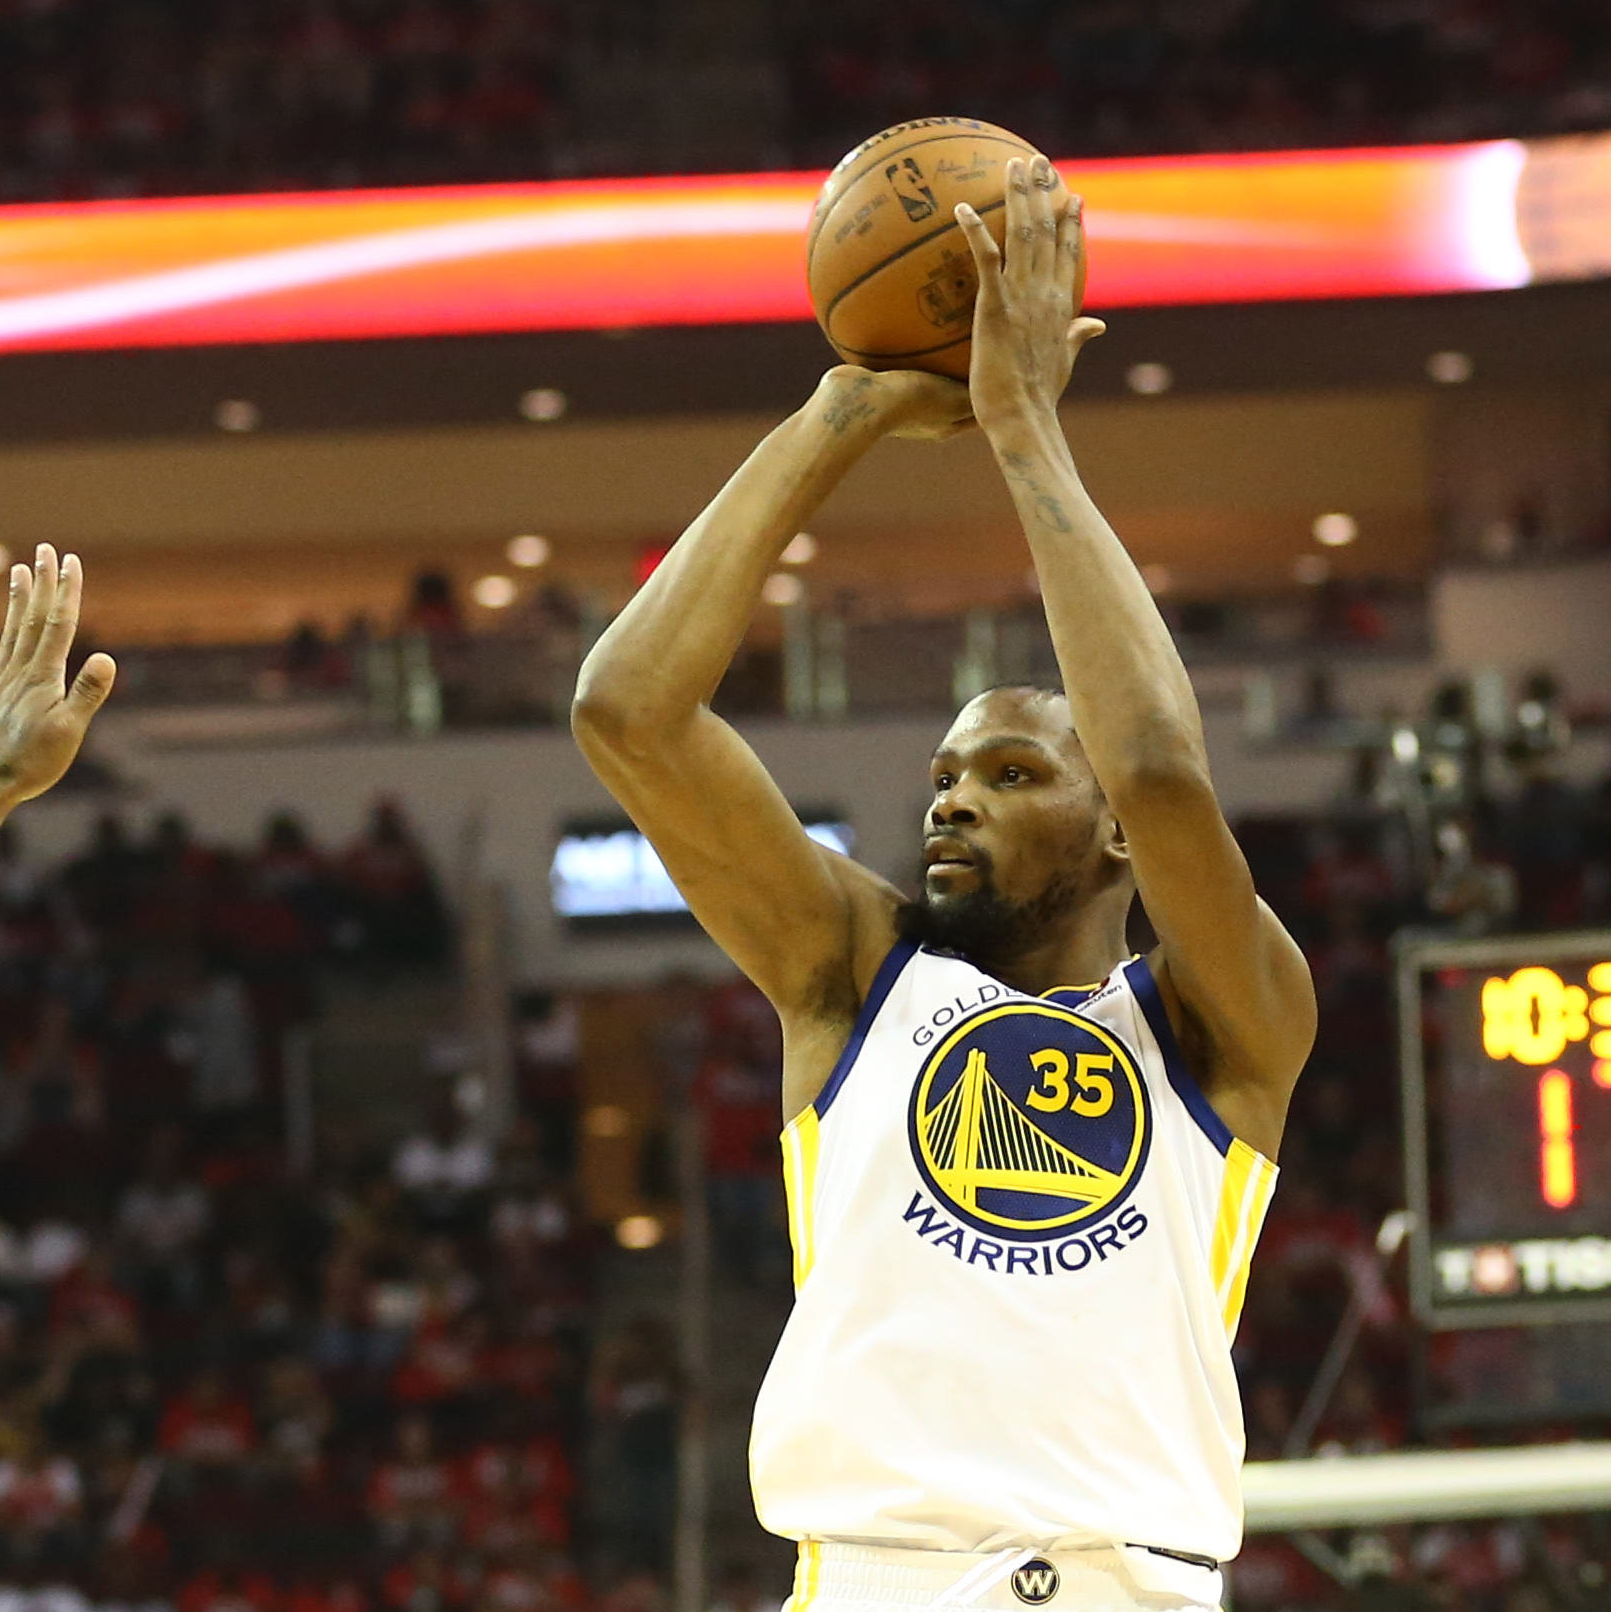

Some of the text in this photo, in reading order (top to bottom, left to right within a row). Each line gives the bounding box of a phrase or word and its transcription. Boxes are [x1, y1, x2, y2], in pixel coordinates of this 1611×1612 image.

[1026, 1048, 1114, 1118] 35
[902, 1175, 1149, 1276] WARRIORS
[1018, 1569, 1055, 1597] W
